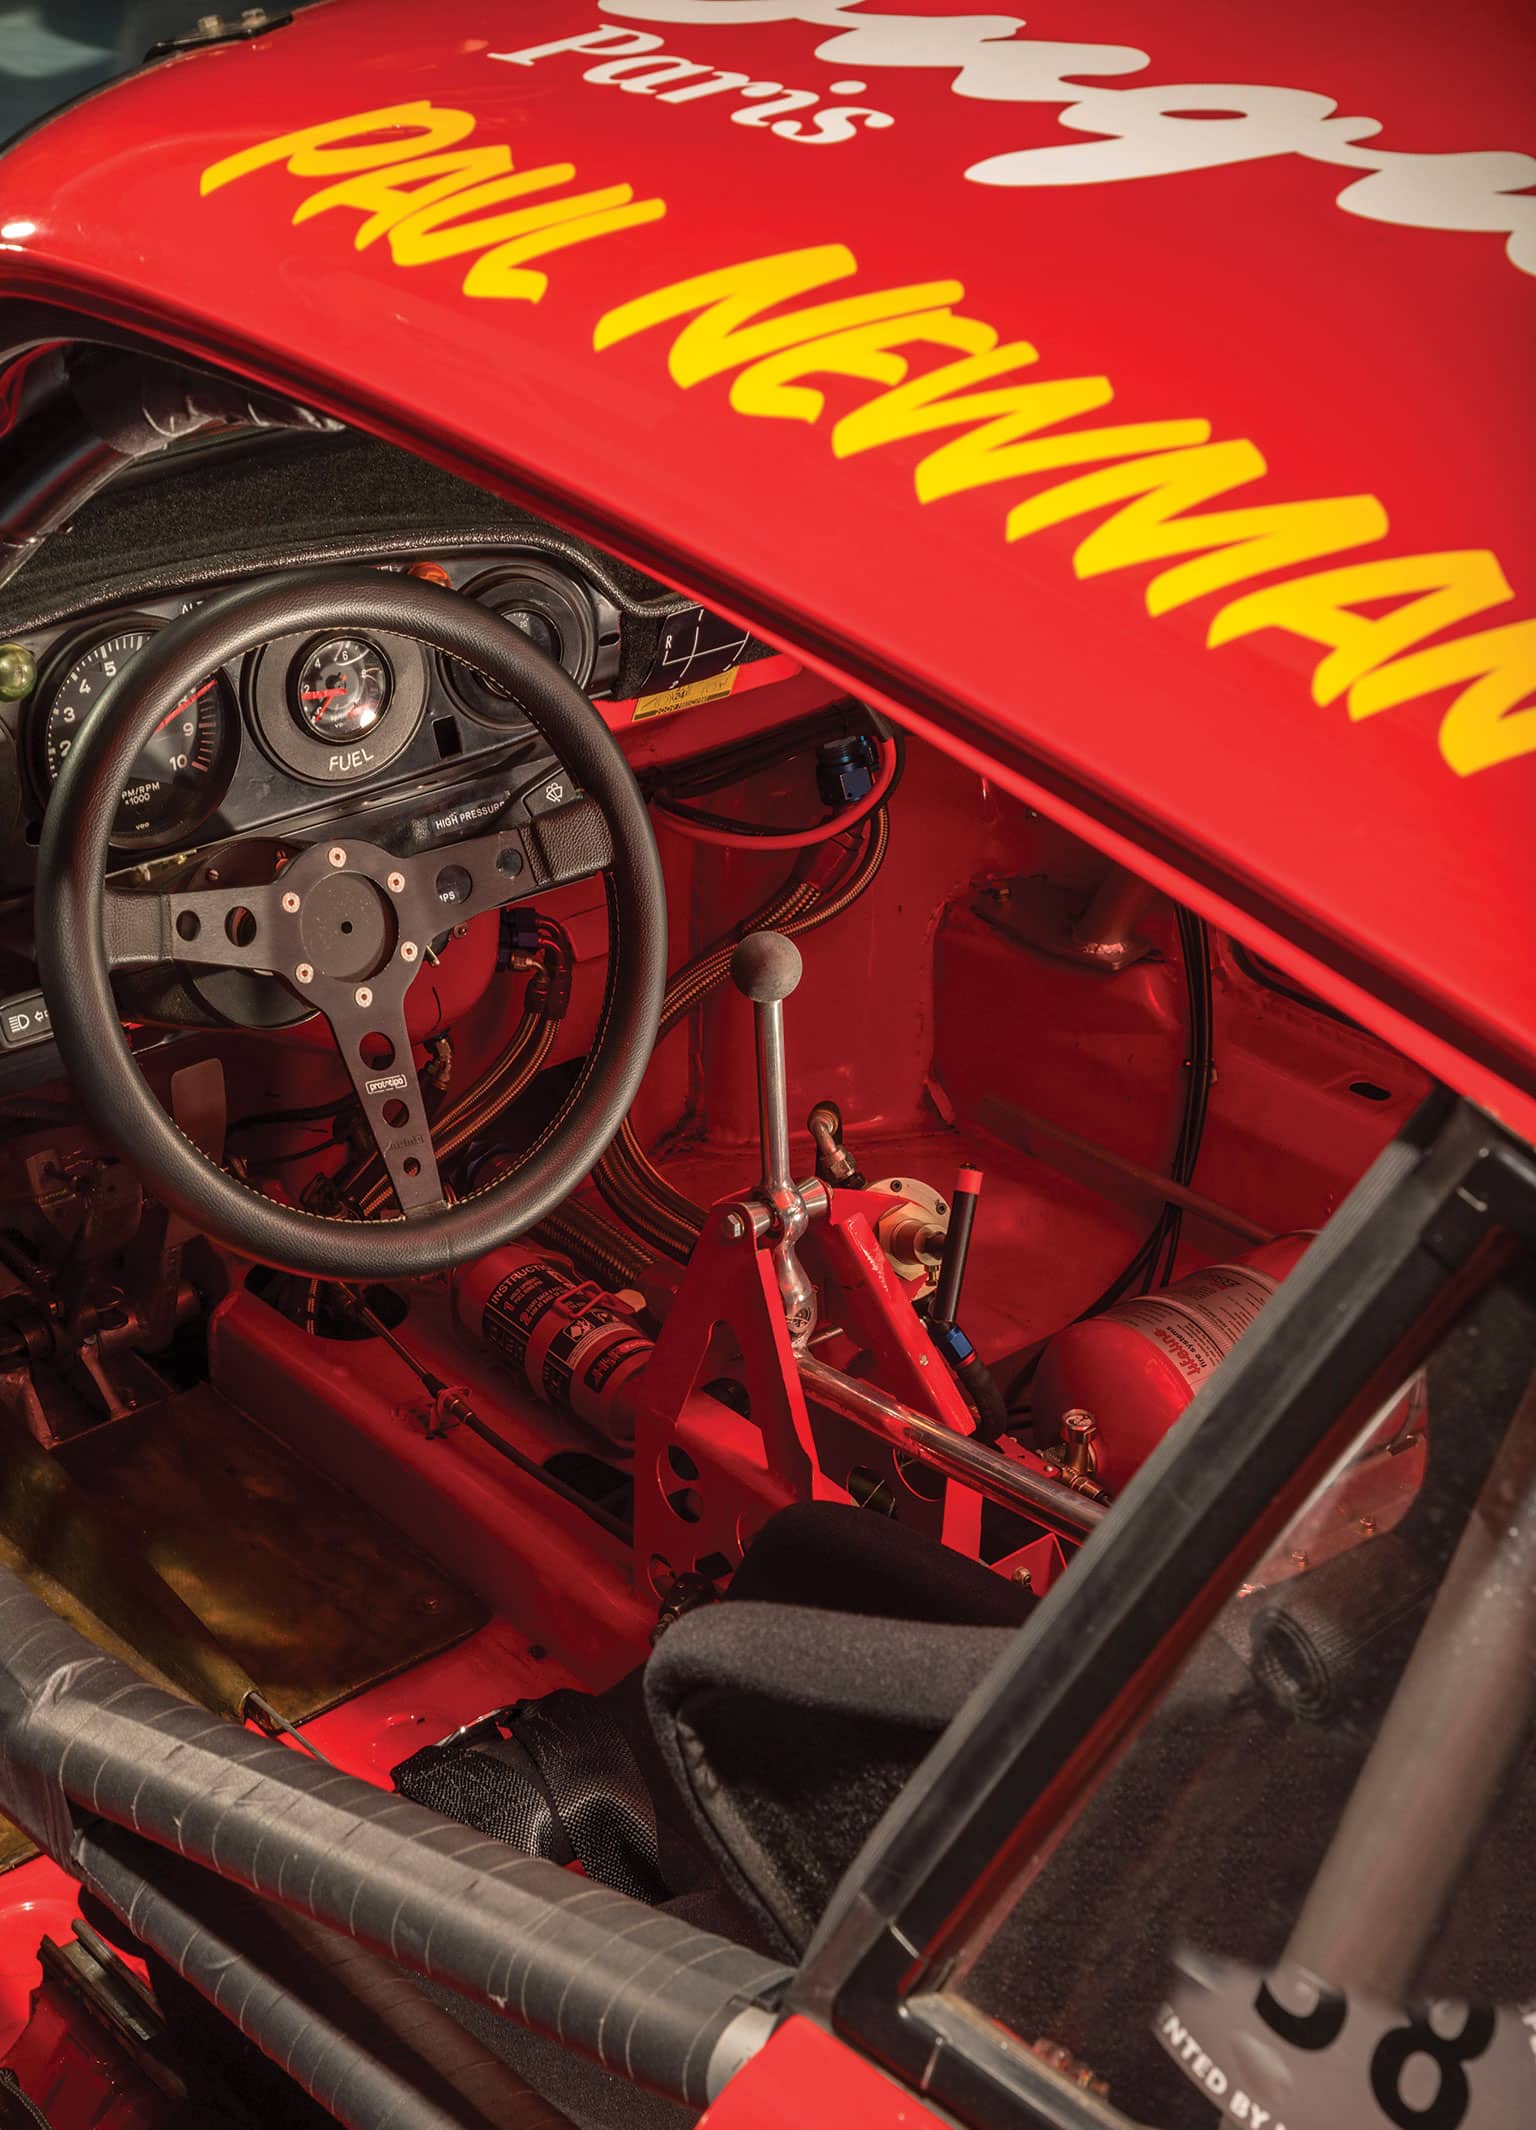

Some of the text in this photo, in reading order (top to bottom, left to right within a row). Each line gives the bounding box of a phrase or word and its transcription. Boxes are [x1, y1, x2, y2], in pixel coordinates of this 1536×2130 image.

[488, 23, 895, 144] Paris
[200, 100, 667, 303] PAUL
[665, 635, 673, 649] R
[104, 661, 117, 676] 5
[79, 679, 91, 695] 4
[63, 707, 75, 723] 3
[183, 722, 194, 736] 9
[169, 753, 188, 771] 10
[328, 748, 375, 771] FUEL
[435, 814, 459, 830] HIGH
[518, 1312, 532, 1327] 2
